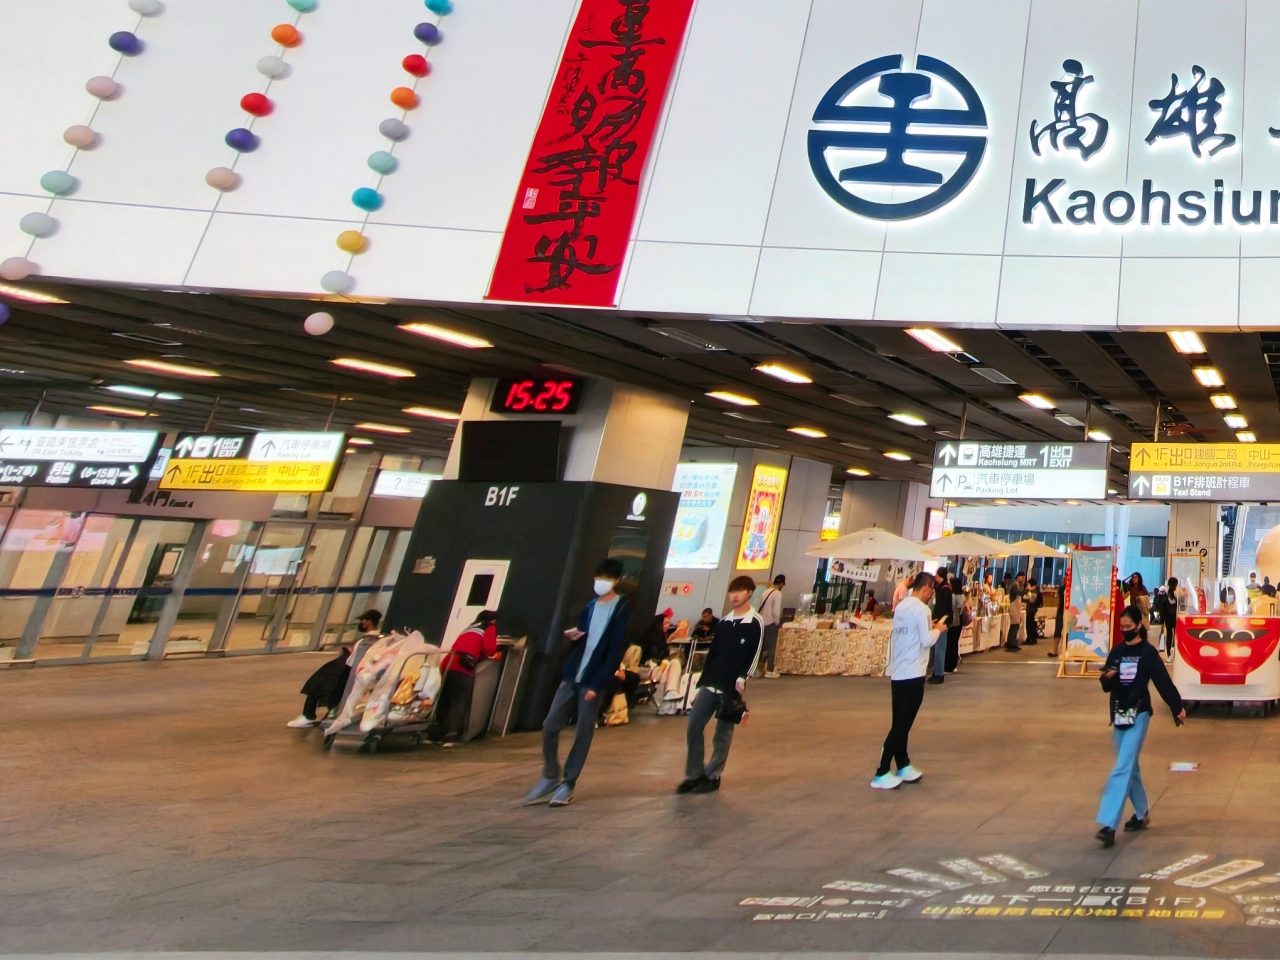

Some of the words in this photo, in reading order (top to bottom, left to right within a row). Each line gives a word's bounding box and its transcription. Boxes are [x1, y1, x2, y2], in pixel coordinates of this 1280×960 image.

[979, 445, 1027, 459] 高雄捷運
[1039, 445, 1049, 468] 1
[1050, 445, 1073, 459] 出口
[1019, 458, 1038, 467] MRT
[1050, 459, 1073, 468] EXIT
[976, 473, 1035, 486] 汽車停車場
[484, 486, 520, 507] B1F
[975, 486, 1004, 495] Parking
[1006, 486, 1018, 494] Lot
[1173, 488, 1189, 497] Taxi
[1190, 488, 1211, 497] Stand
